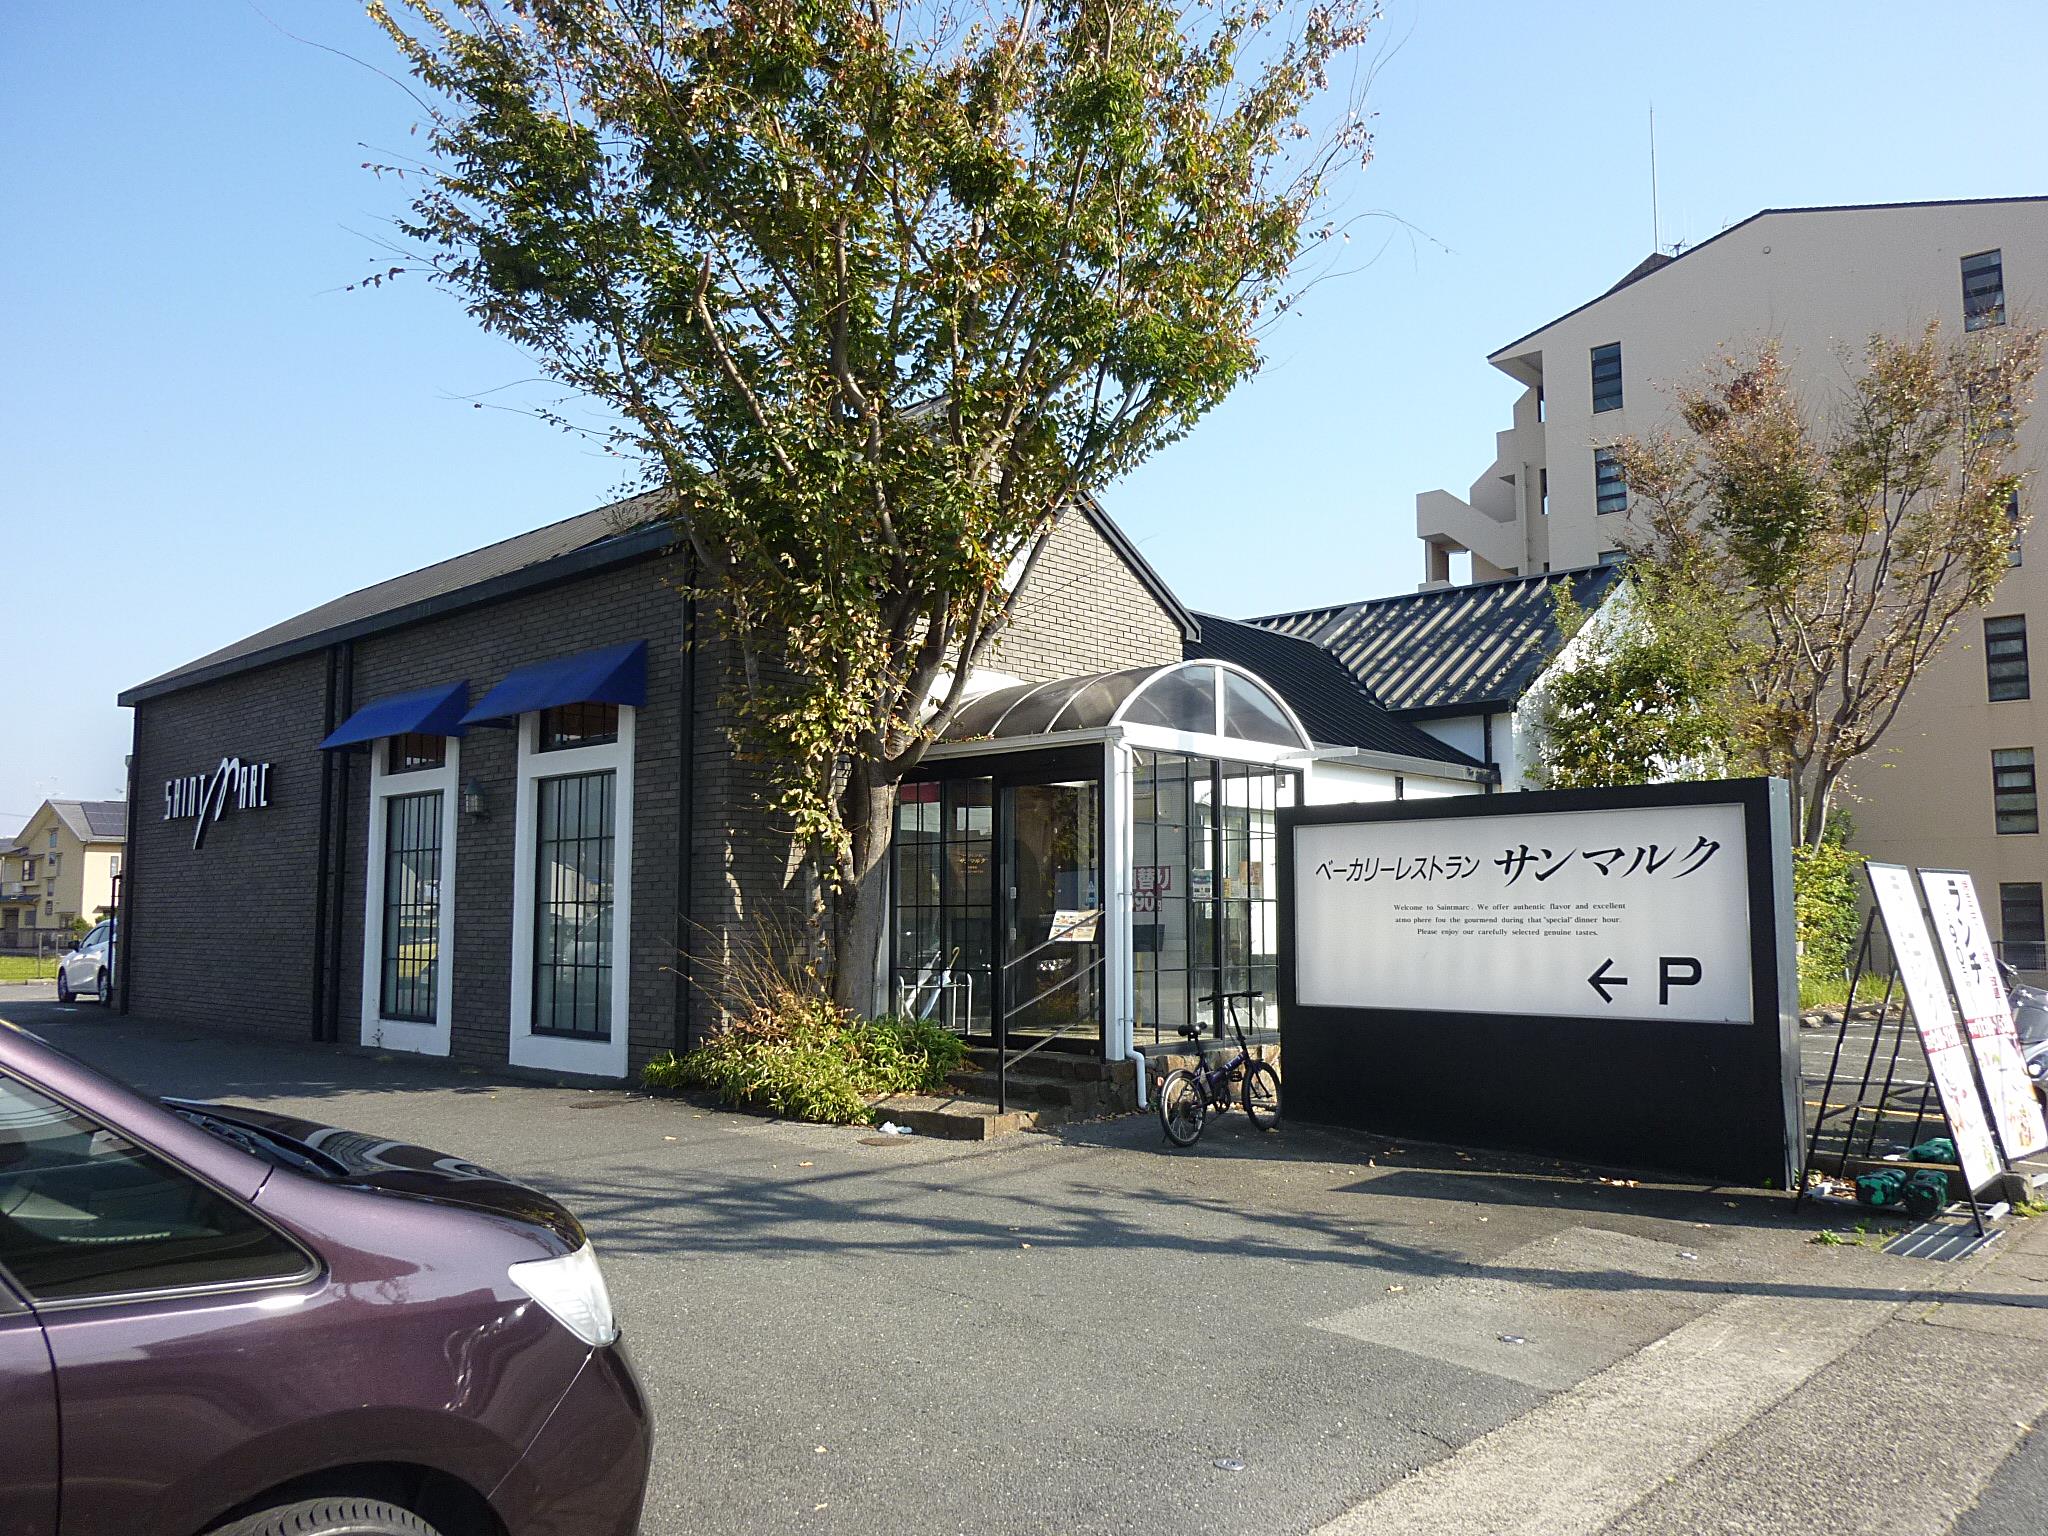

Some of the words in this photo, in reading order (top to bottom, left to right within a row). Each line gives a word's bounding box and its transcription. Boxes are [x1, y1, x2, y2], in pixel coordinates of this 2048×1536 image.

[1315, 855, 1481, 882] ベーカリーレストラン
[1493, 835, 1721, 888] サンマルク
[1477, 903, 1489, 911] We
[1492, 903, 1510, 911] offer
[1575, 902, 1589, 910] and
[1592, 902, 1626, 910] excellent
[1501, 916, 1524, 924] during
[1441, 928, 1459, 936] enjoy
[1477, 928, 1508, 936] carefully
[1658, 956, 1703, 1006] P
